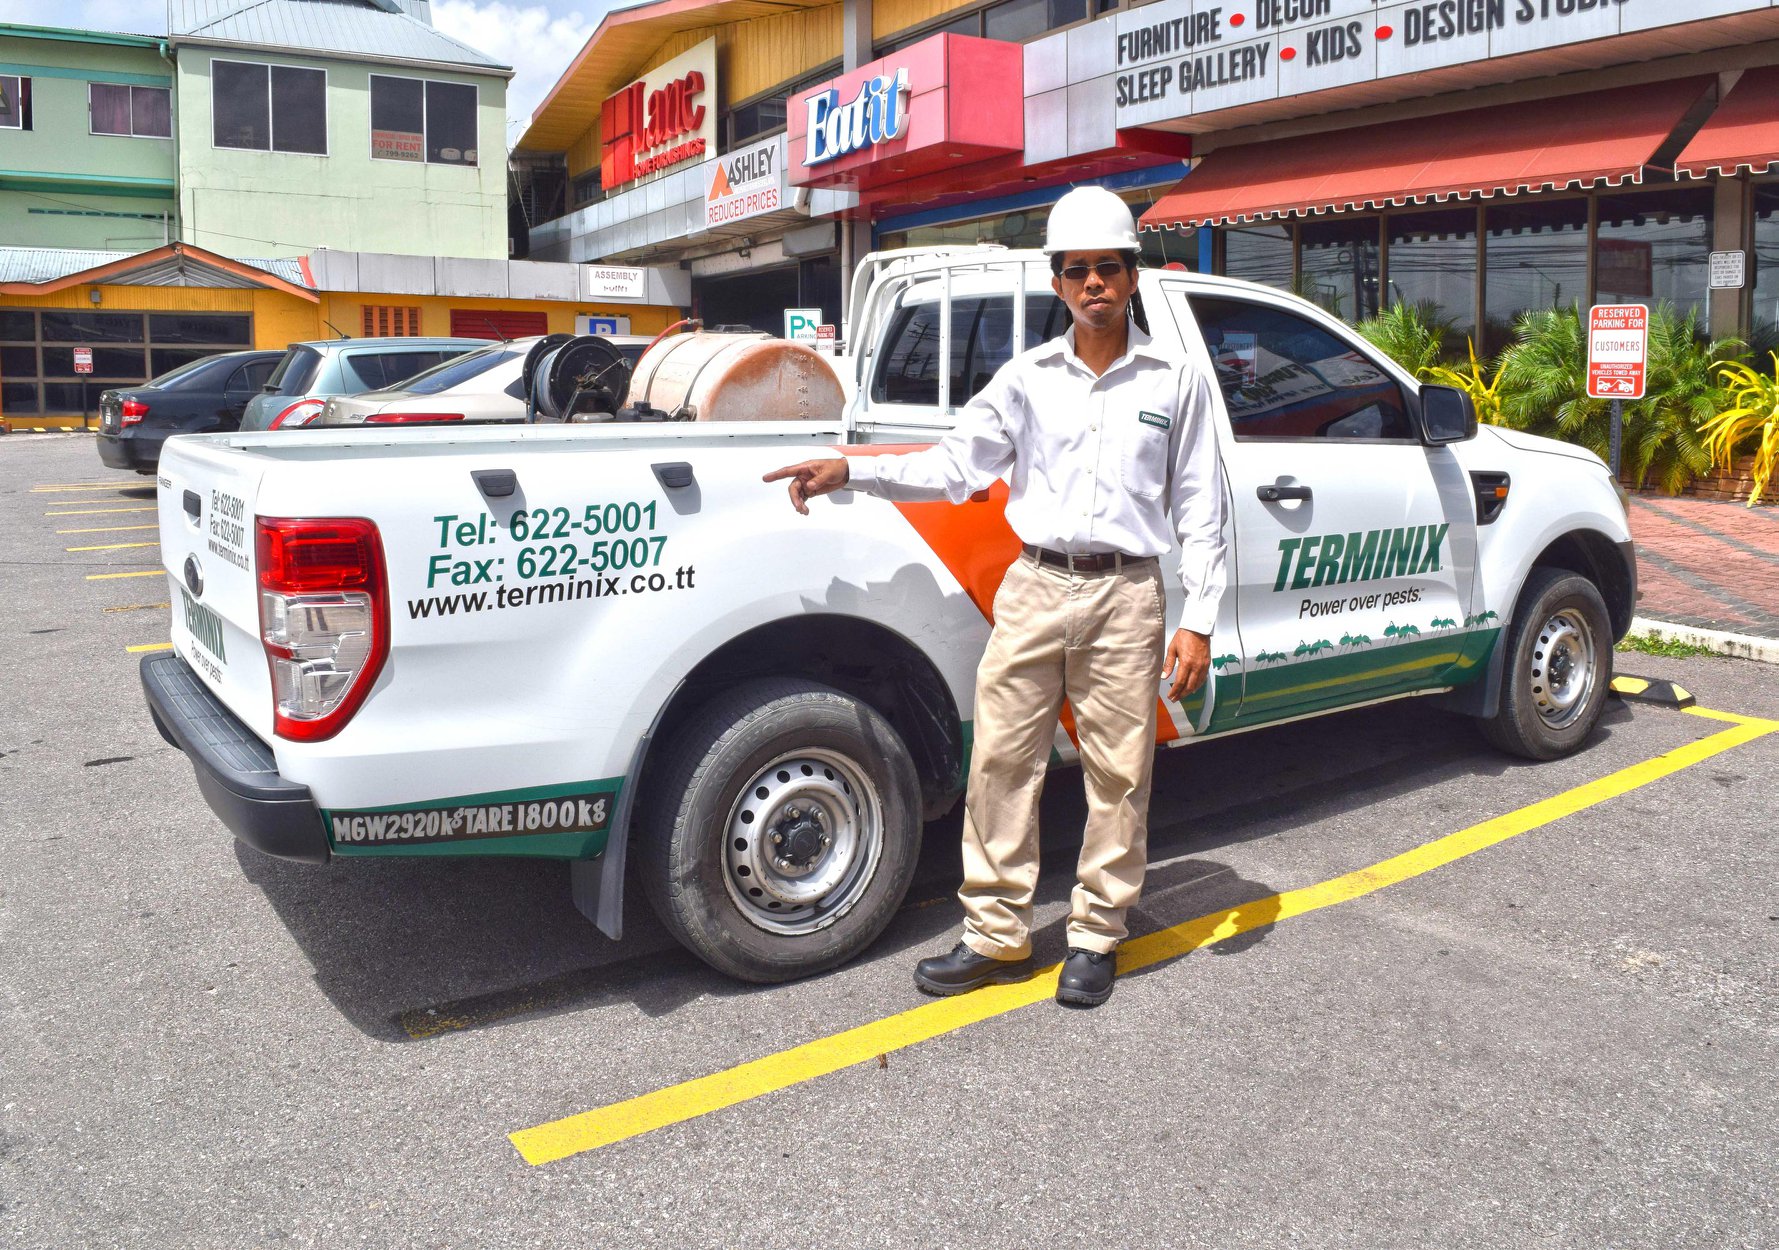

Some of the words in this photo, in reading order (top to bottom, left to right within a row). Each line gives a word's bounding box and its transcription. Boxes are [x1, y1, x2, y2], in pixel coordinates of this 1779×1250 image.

[1116, 65, 1172, 108] SLEEP
[1179, 42, 1270, 94] GALLERY
[1306, 21, 1363, 68] KIDS
[1404, 0, 1505, 47] DESIGN
[1117, 7, 1222, 65] FURNITURE
[631, 71, 706, 155] Lane
[373, 140, 392, 150] FOR
[396, 142, 422, 152] RENT
[726, 144, 775, 188] ASHLEY
[708, 198, 745, 224] REDUCED
[747, 188, 778, 213] PRICES
[595, 271, 637, 281] ASSEMBLY
[1593, 319, 1626, 328] PARKING
[1628, 319, 1644, 328] FOR
[1598, 308, 1640, 317] RESERVED
[1595, 341, 1640, 351] CUSTOMERS
[212, 489, 220, 512] Tel:
[220, 493, 245, 522] 622-5001
[433, 512, 497, 548] Tel:
[509, 500, 657, 542] 622-5001
[220, 518, 244, 548] 622-5007
[426, 553, 505, 588] Fax:
[516, 535, 668, 580] 622-5007
[1273, 523, 1450, 592] TERMINIX
[408, 564, 695, 619] www.terminix.co.tt
[1299, 598, 1347, 619] Power
[1349, 593, 1382, 611] over
[1382, 585, 1423, 612] pests.
[180, 586, 228, 666] TERMINIX
